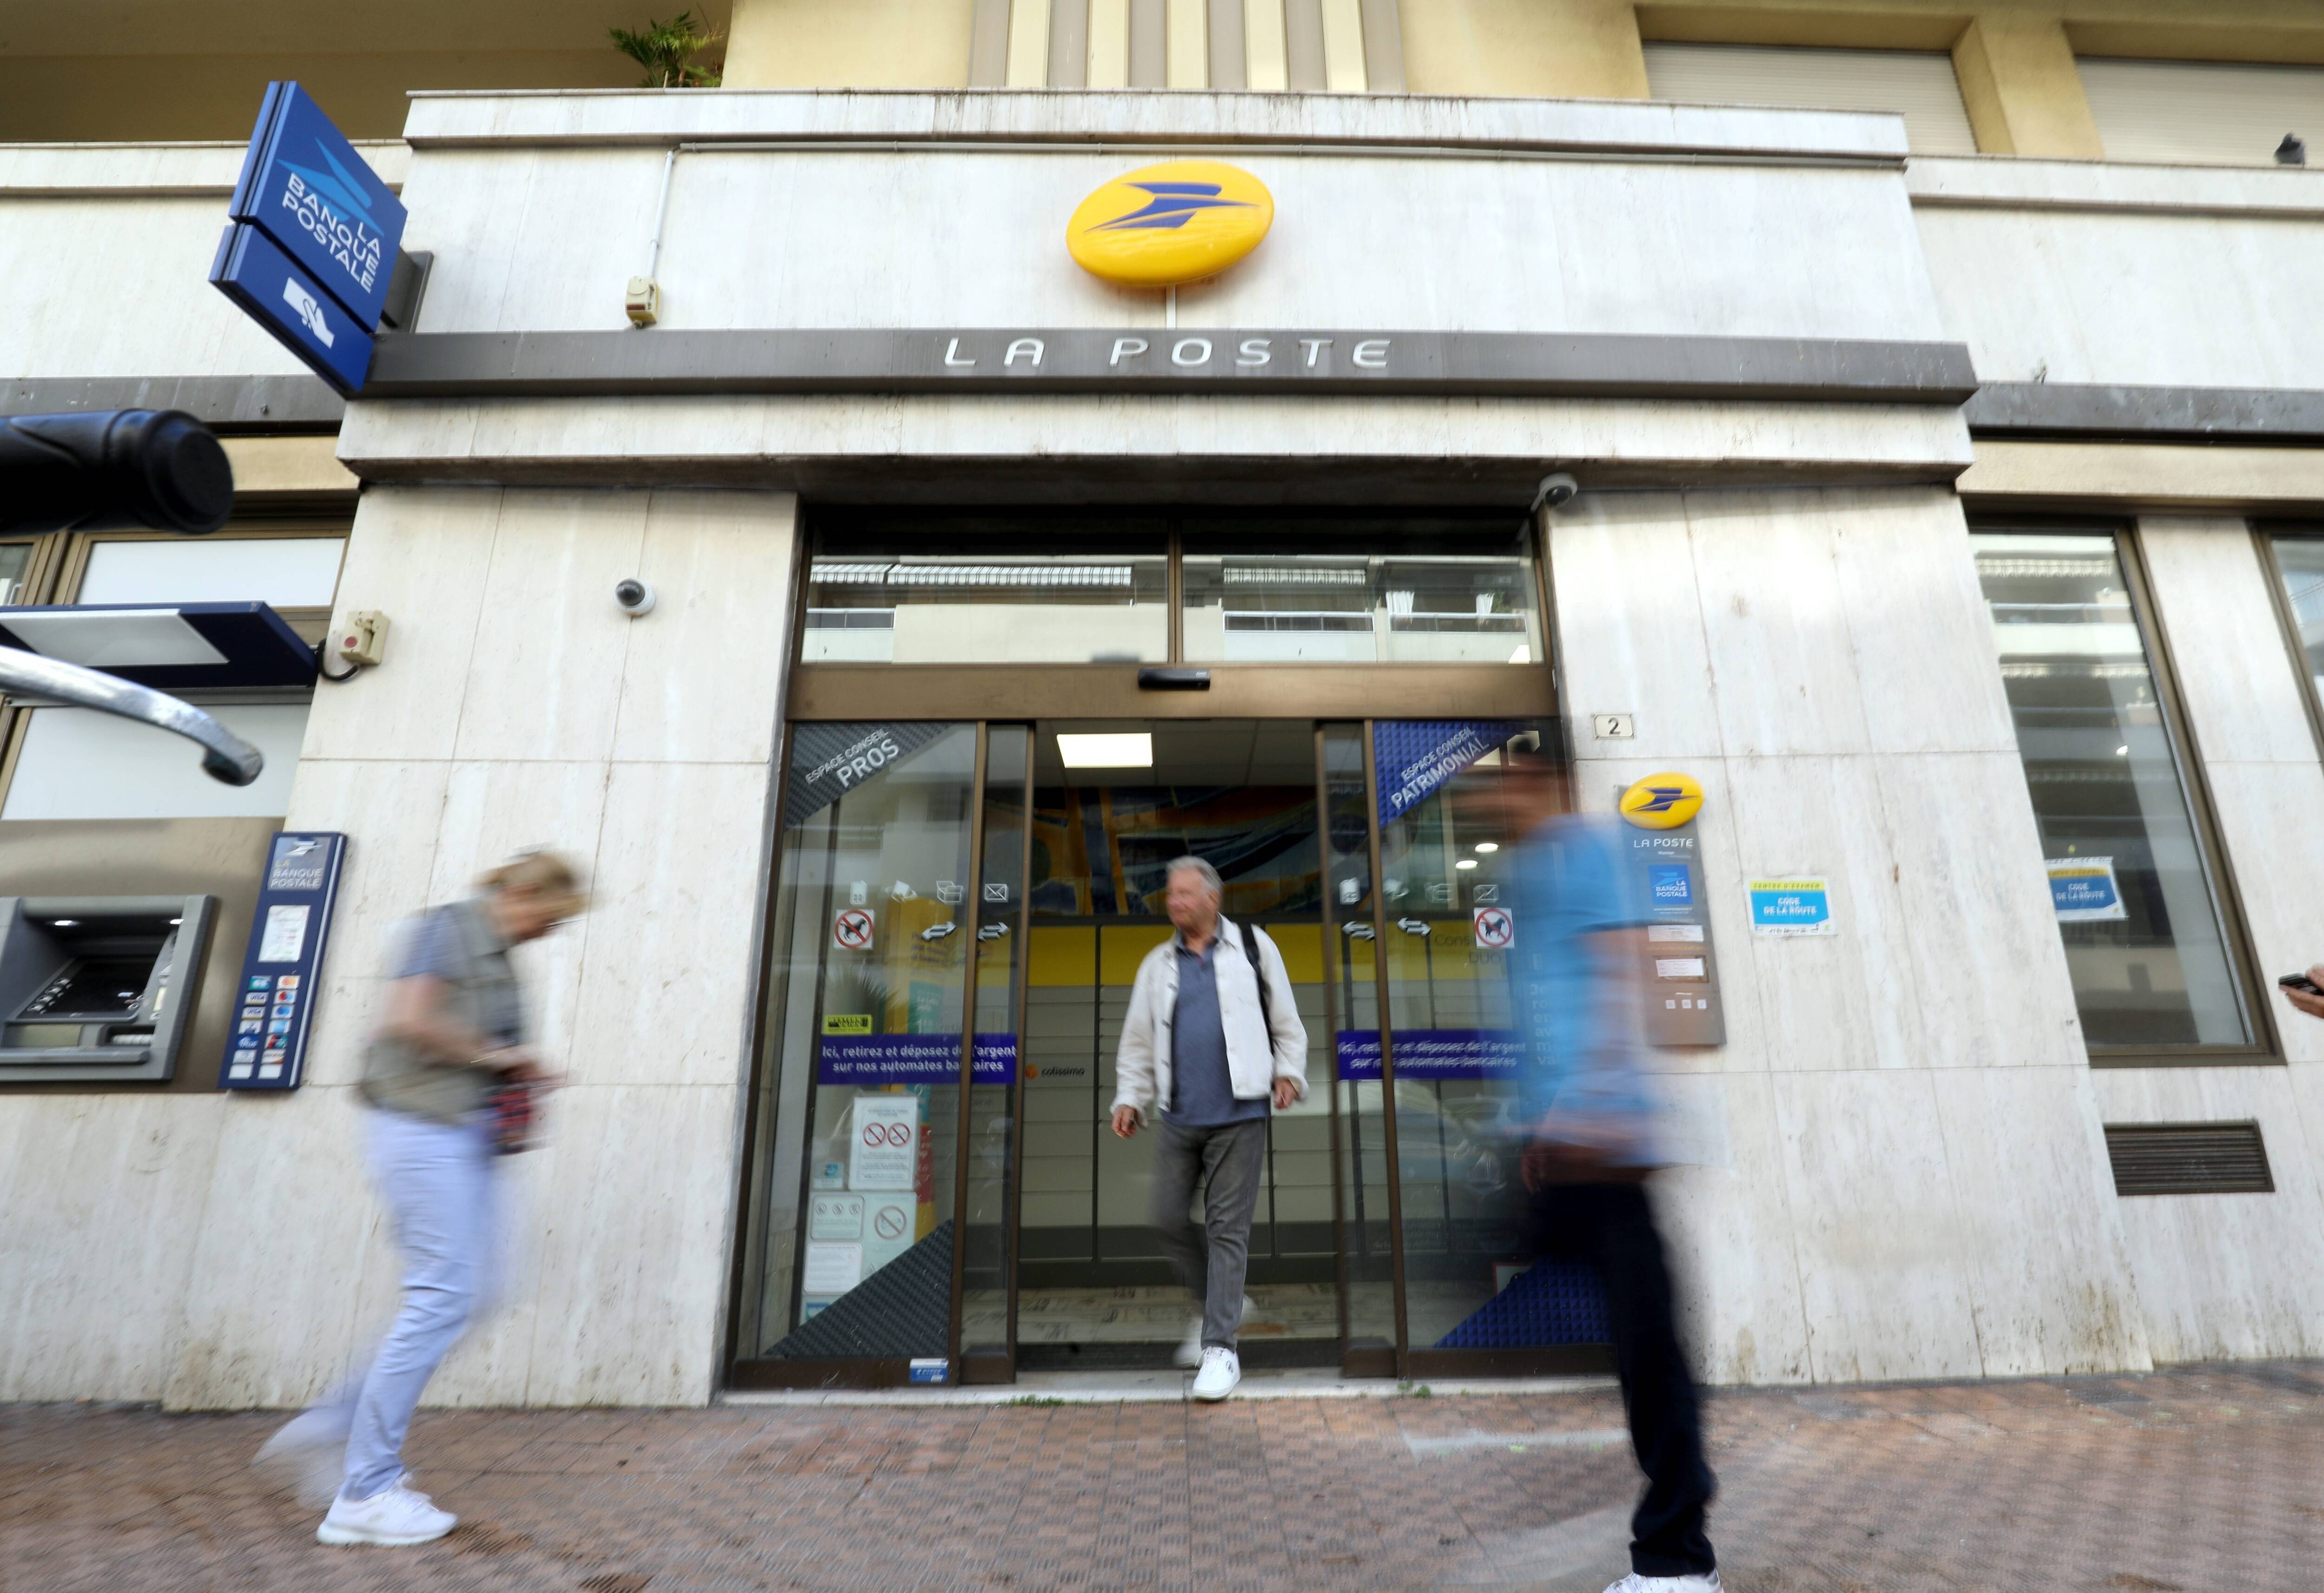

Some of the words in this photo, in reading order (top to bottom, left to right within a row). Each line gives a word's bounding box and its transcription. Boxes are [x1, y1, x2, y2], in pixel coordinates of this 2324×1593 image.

[287, 172, 380, 277] BANQUE
[282, 191, 375, 295] POSTALE
[357, 221, 381, 260] LA
[943, 336, 1045, 368] LA
[1109, 336, 1392, 369] POSTE
[1608, 717, 1621, 735] 2
[836, 738, 899, 788] PROS
[1401, 751, 1438, 782] ESPACE
[1436, 726, 1476, 757] CONSEIL
[805, 753, 846, 784] ESPACE
[1390, 736, 1490, 810] PATRIMONIAL
[1633, 839, 1650, 848] LA
[1653, 838, 1694, 849] POSTE
[270, 878, 321, 889] POSTALE
[273, 868, 323, 878] BANQUE
[1776, 906, 1788, 916] LA
[1789, 906, 1817, 916] ROUTE
[822, 1046, 840, 1060] Ici,
[843, 1046, 883, 1058] retirez
[885, 1046, 898, 1058] et
[900, 1044, 949, 1060] déposez
[832, 1062, 853, 1073] sur
[856, 1062, 878, 1073] nos
[880, 1060, 944, 1073] automates
[945, 1059, 1005, 1073] baaires
[1041, 1066, 1085, 1077] colissimo
